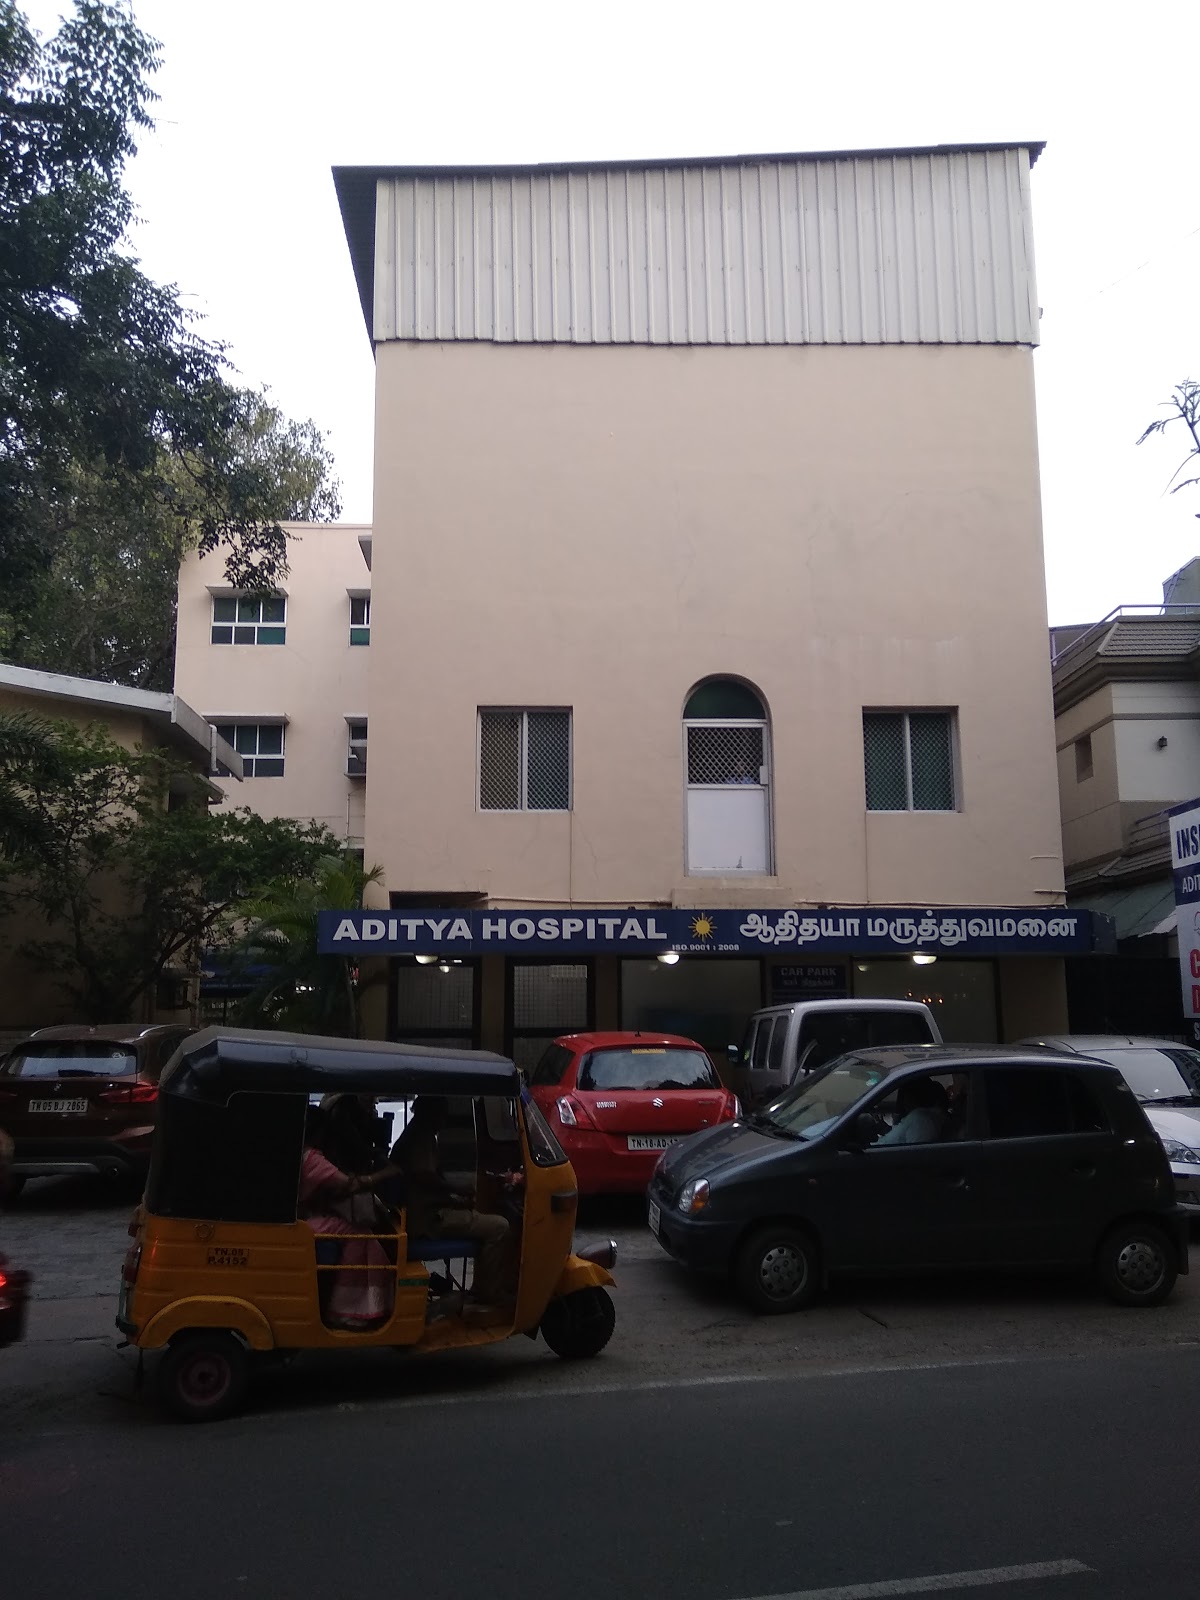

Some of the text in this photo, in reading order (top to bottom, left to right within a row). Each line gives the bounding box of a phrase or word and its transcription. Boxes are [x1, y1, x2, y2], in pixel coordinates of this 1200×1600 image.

[1176, 823, 1200, 860] INS
[332, 918, 668, 941] ADITYA HOSPITAL
[739, 909, 1078, 947] ஆதிதயா மருத்துவமனை
[717, 943, 740, 952] 2008
[780, 967, 838, 976] CAR PARK
[66, 1101, 86, 1111] 2865
